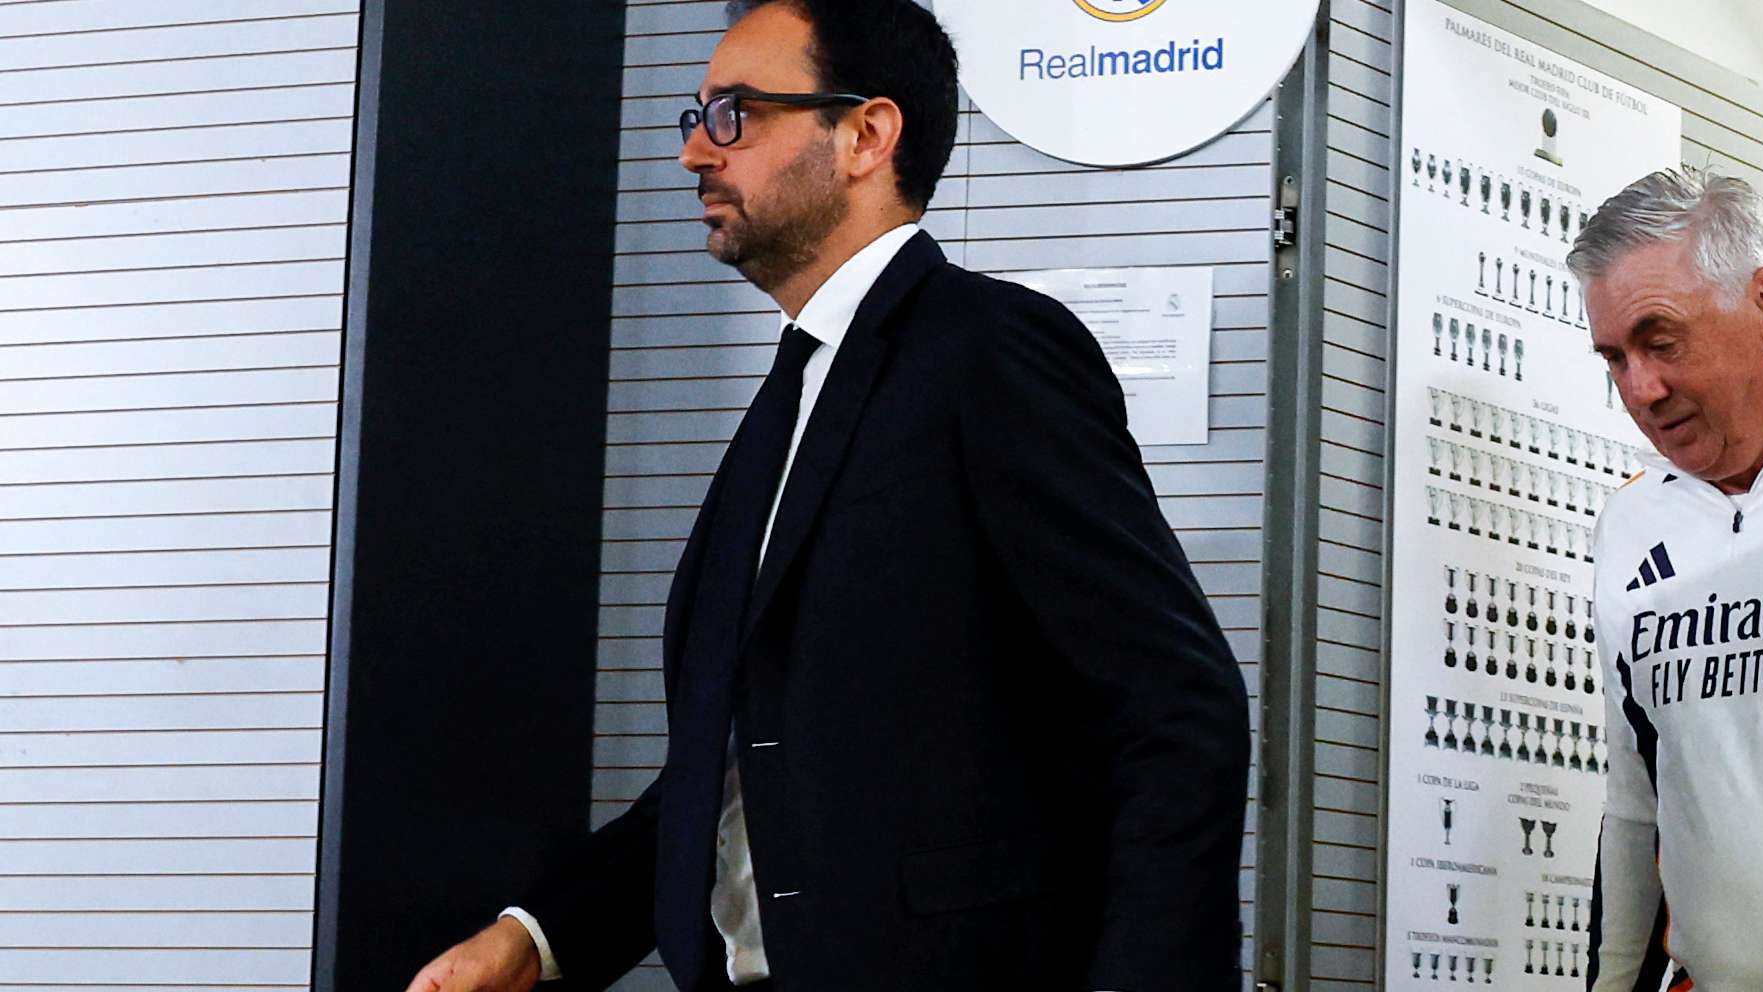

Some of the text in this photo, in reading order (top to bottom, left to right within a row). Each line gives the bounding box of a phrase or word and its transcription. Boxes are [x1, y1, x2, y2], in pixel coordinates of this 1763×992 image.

[1020, 38, 1224, 81] Realmadrid
[1514, 47, 1535, 68] REAL
[1538, 58, 1575, 84] MADRID
[1651, 658, 1692, 708] FLY
